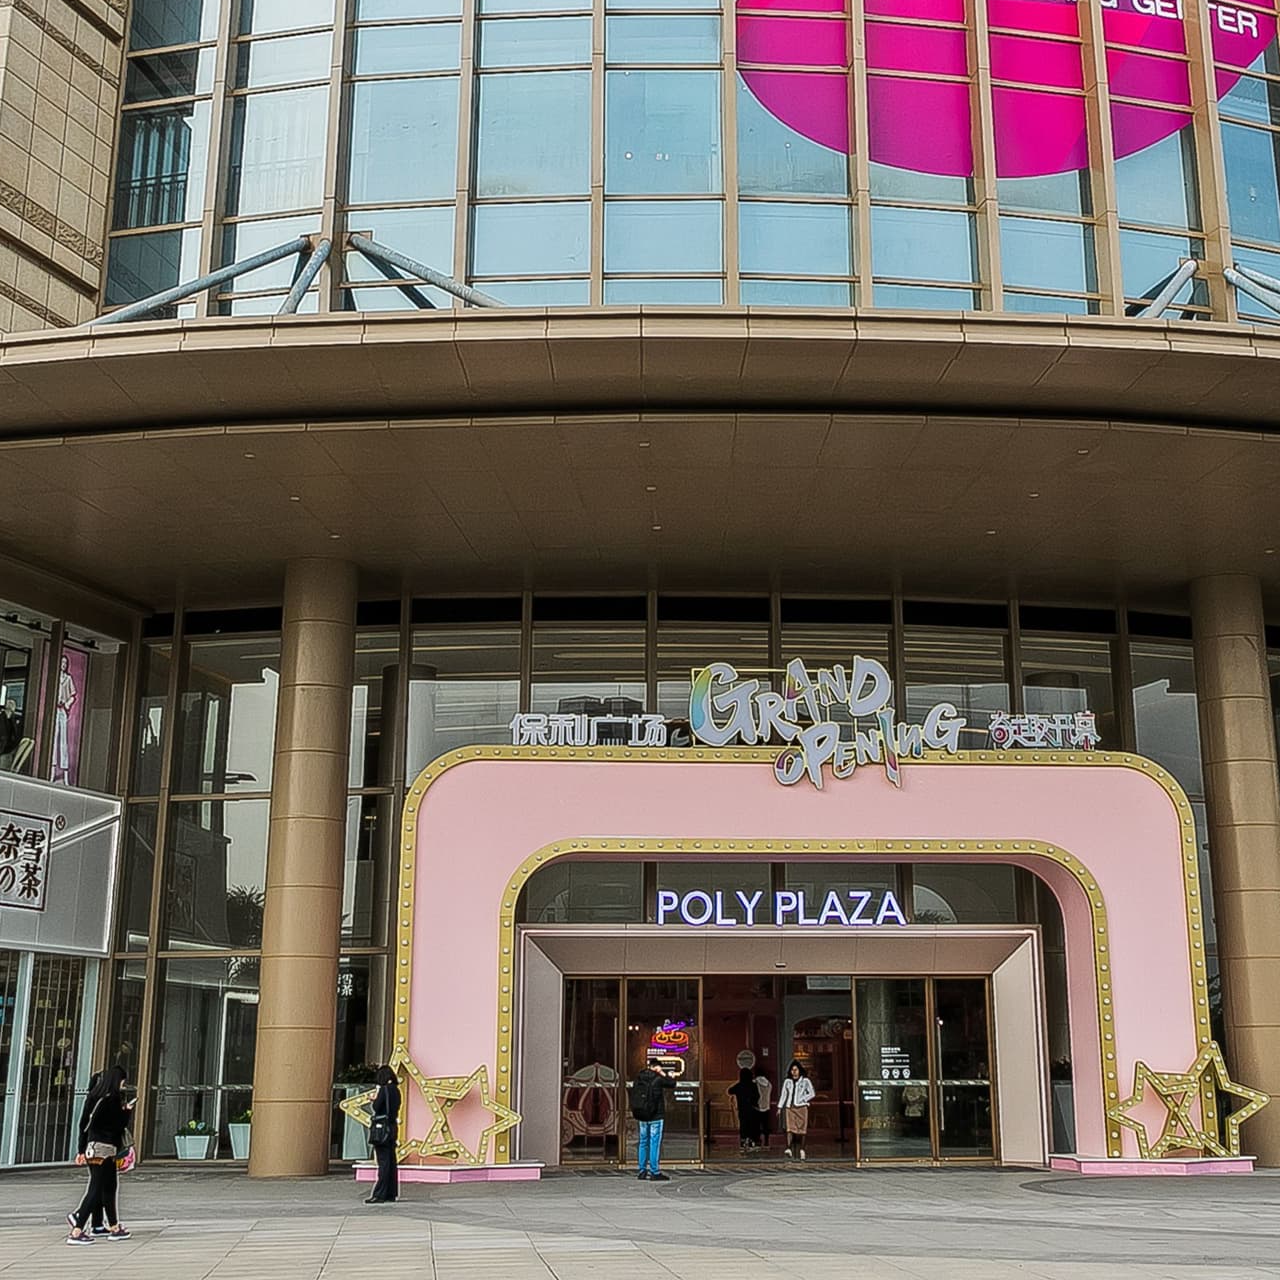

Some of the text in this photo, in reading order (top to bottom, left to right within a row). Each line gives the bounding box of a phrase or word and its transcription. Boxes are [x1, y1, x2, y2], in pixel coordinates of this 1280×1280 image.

[690, 654, 893, 747] GRAND
[508, 712, 668, 747] 保利广场
[773, 702, 967, 791] OPENING
[988, 710, 1102, 751] 奇趣开幕
[656, 889, 908, 926] POLY PLAZA
